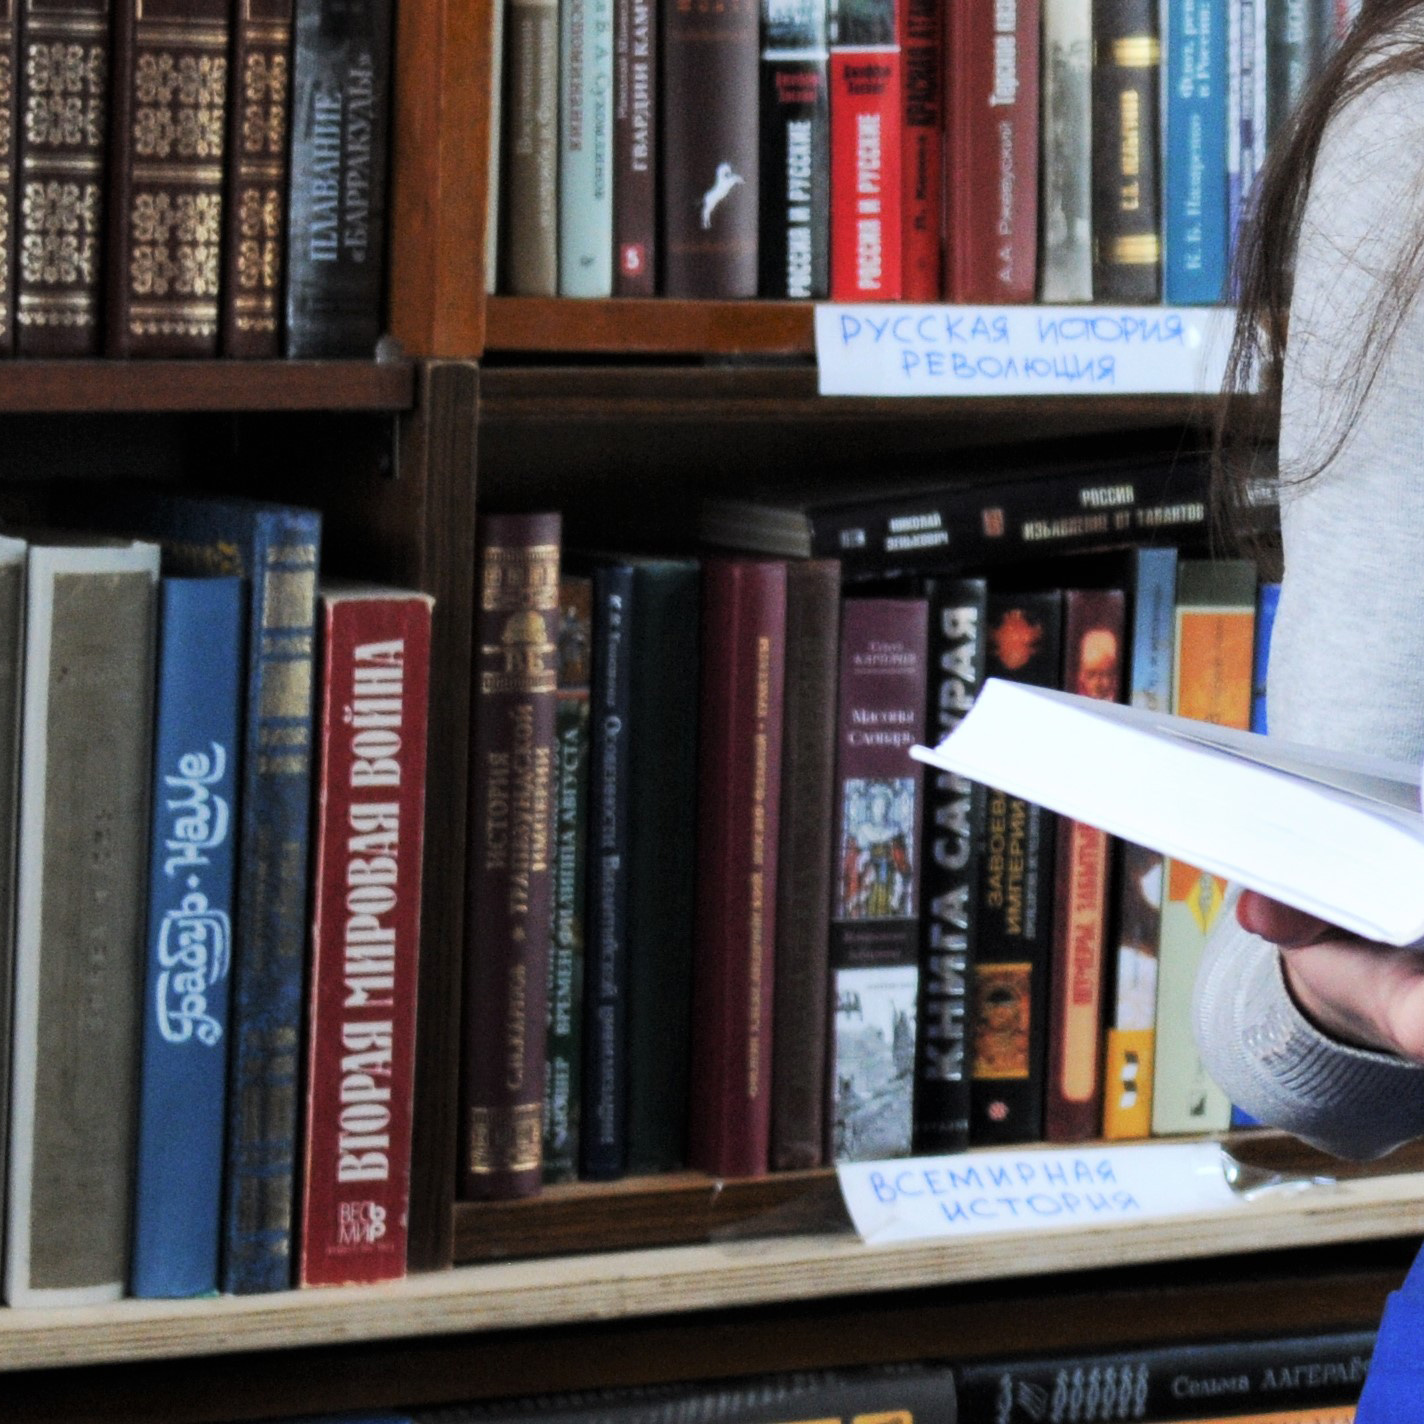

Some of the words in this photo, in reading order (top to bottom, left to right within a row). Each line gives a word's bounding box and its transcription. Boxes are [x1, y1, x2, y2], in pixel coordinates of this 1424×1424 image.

[840, 313, 1011, 346] РУССКАЯ
[901, 349, 1117, 384] РЕВОЛЮЦИЯ
[343, 639, 404, 788] ВОЙНА
[341, 803, 398, 1008] МИРОВАЯ
[926, 885, 970, 1082] КНИГА
[336, 1021, 393, 1183] ВТОРАЯ
[870, 1158, 1118, 1204] ВСЕМИРНАЯ
[940, 1190, 1141, 1225] ИСТОРИЯ
